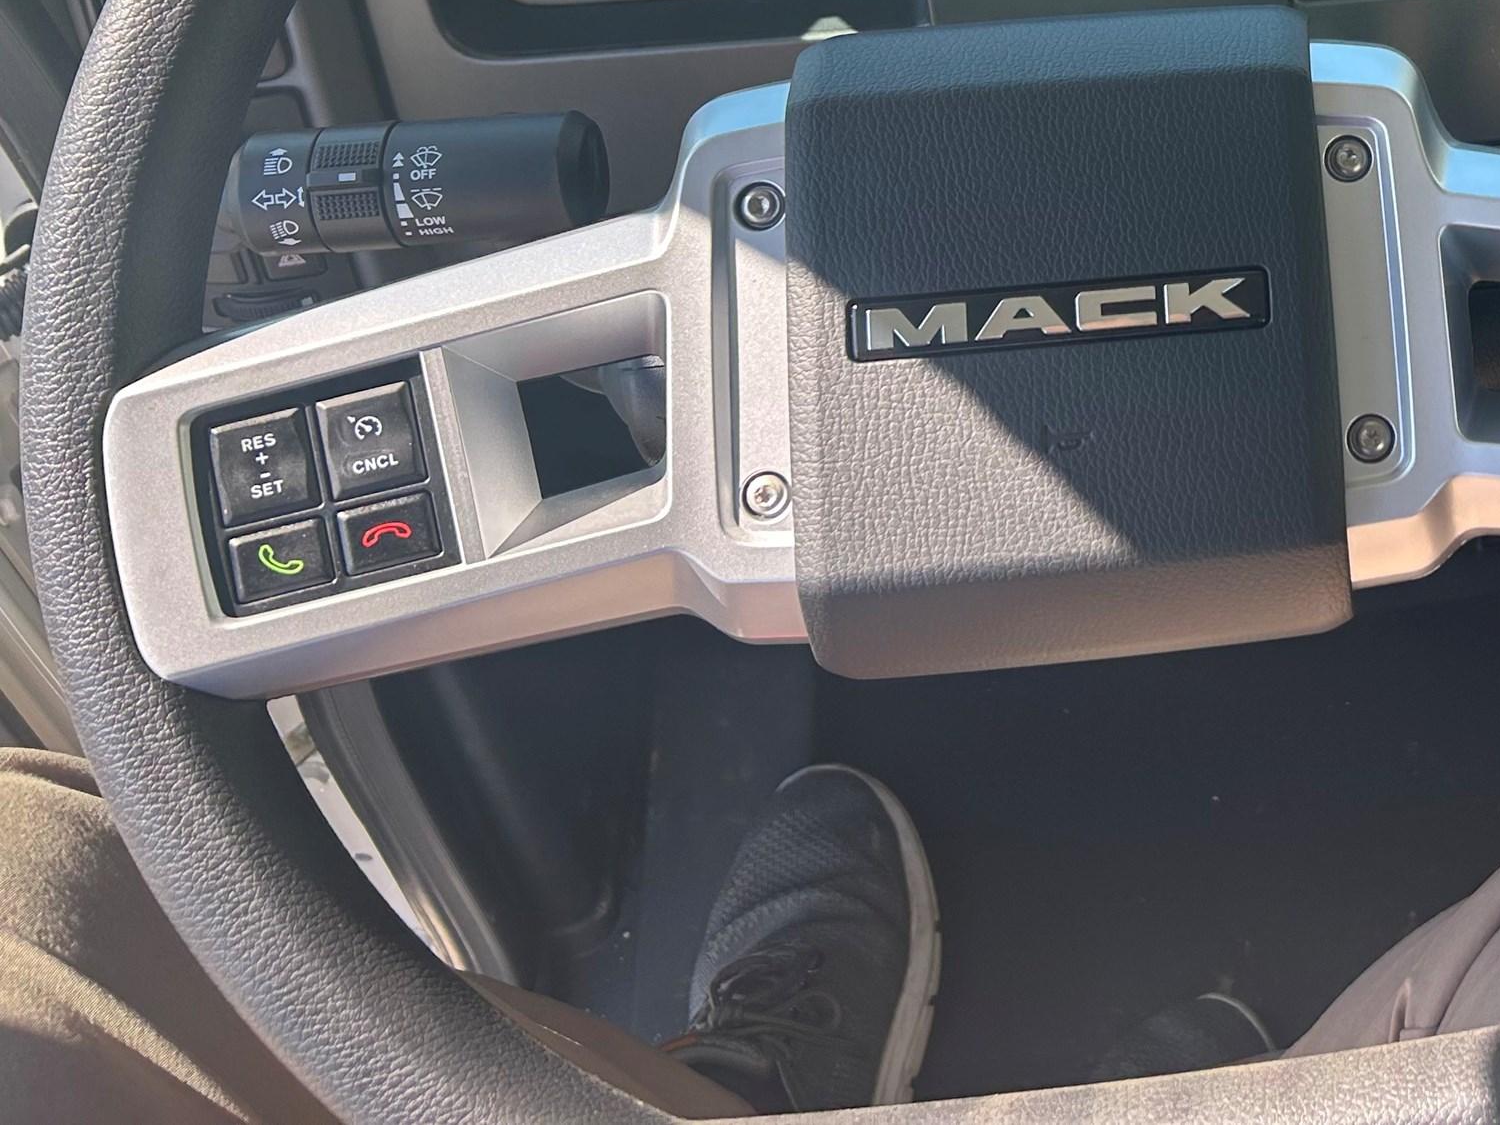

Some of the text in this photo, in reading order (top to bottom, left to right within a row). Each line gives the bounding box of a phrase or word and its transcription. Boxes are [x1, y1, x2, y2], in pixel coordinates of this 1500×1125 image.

[410, 167, 436, 181] OFF
[415, 215, 446, 227] LOW
[418, 225, 454, 236] HIGH
[866, 277, 1250, 351] MACK
[241, 433, 277, 453] RES
[352, 452, 399, 475] CNCL
[250, 479, 284, 499] SET
